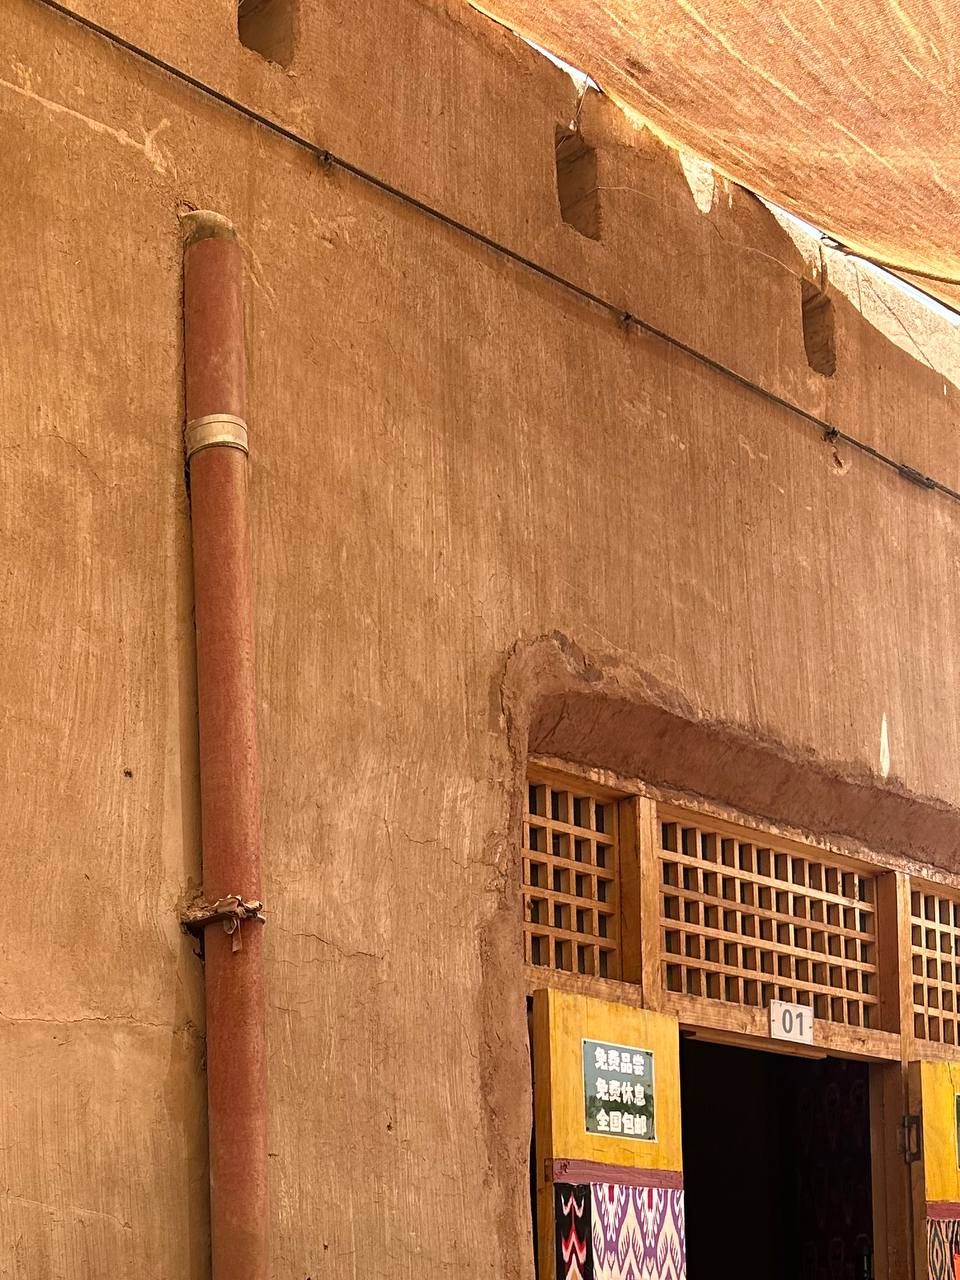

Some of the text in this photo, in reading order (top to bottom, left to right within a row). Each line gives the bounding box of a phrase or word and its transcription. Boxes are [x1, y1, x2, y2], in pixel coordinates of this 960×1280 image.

[782, 1009, 803, 1036] 01
[595, 1047, 645, 1076] 免费品尝
[596, 1077, 646, 1106] 免费休息
[596, 1108, 647, 1136] 全国包邮
